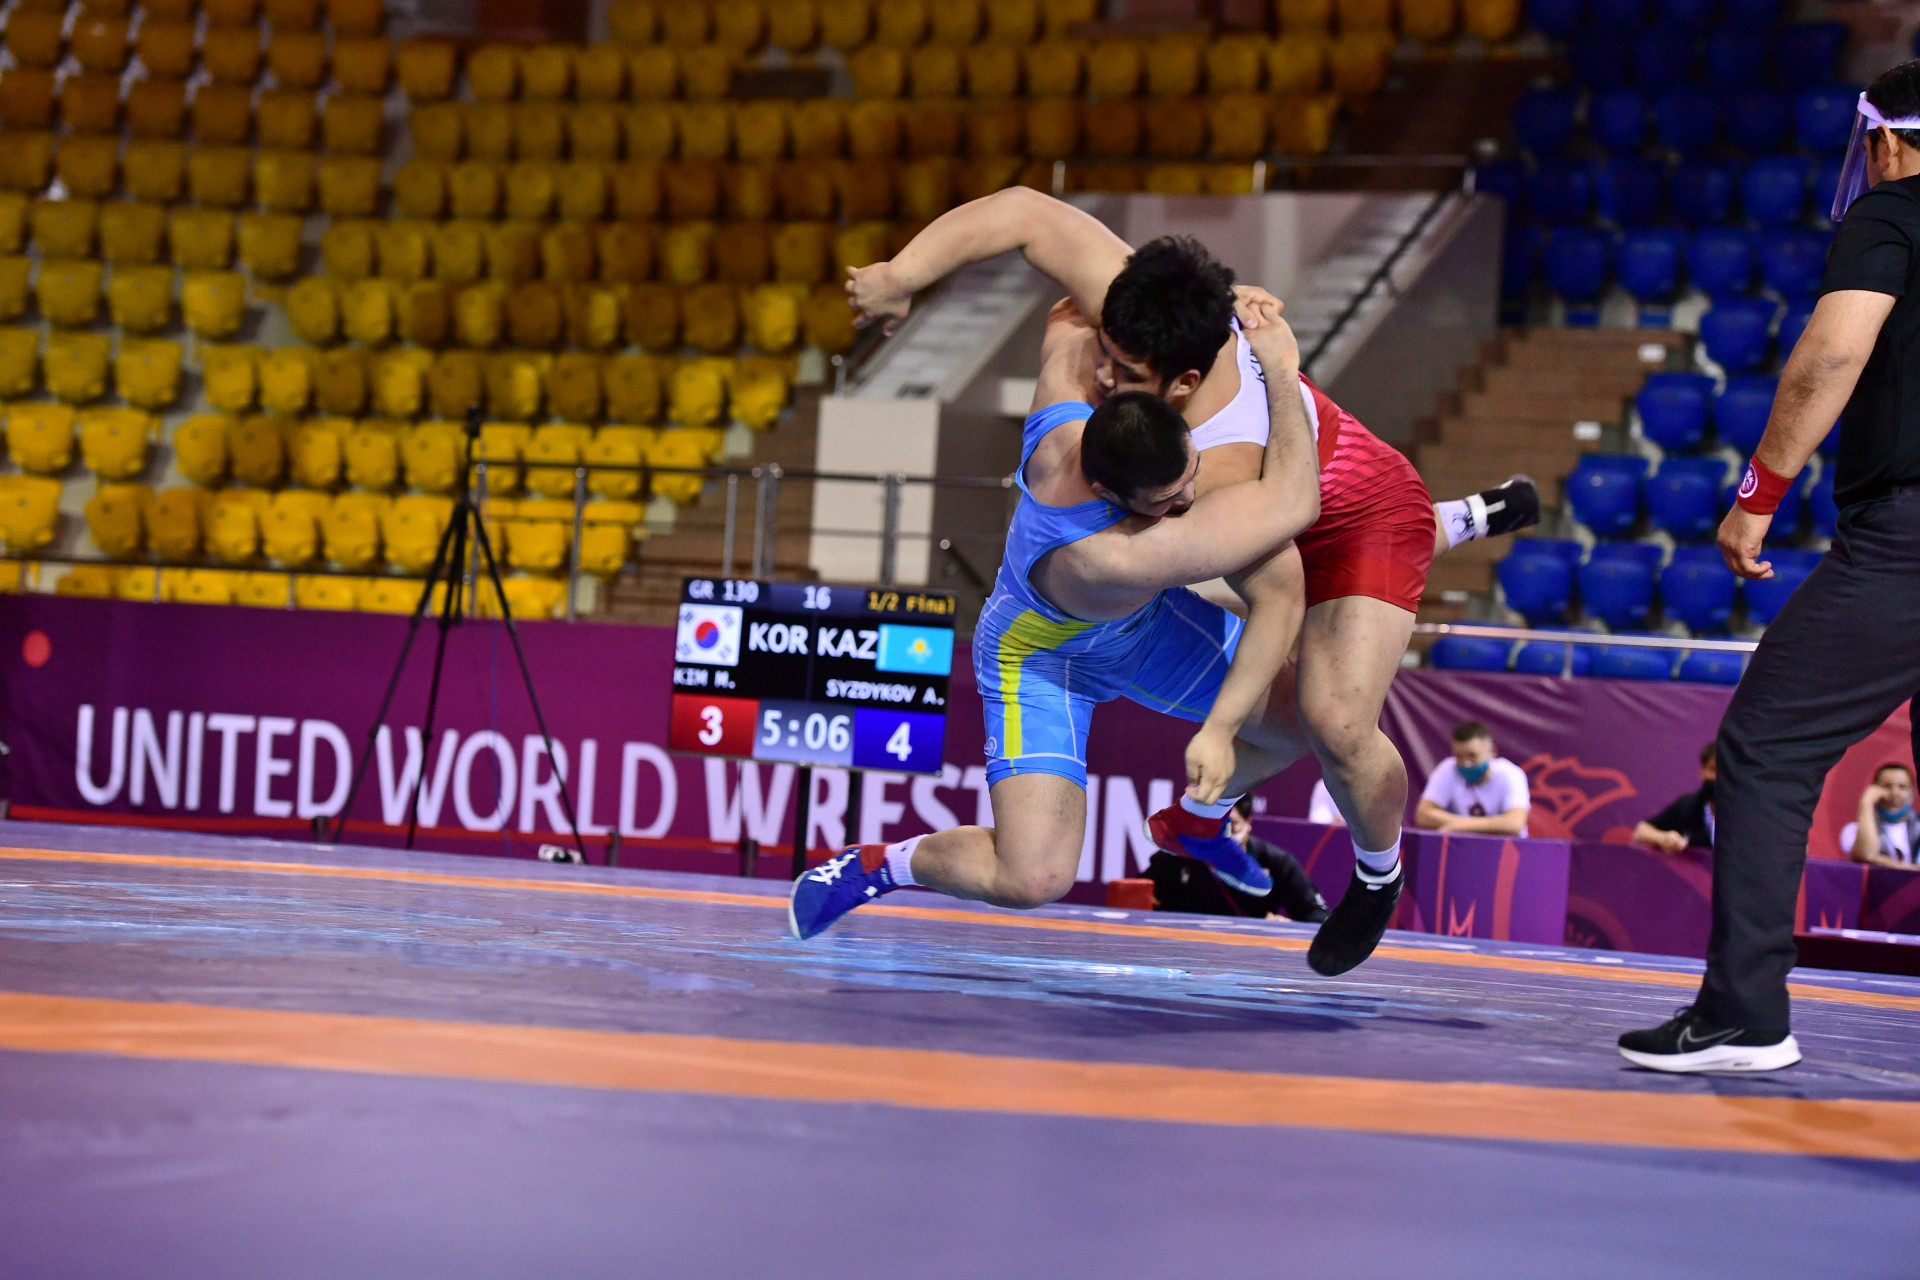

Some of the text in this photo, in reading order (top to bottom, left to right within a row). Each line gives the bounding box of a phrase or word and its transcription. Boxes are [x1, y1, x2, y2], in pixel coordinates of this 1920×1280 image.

[688, 579, 759, 603] GR 130
[803, 585, 831, 610] 16
[868, 591, 955, 614] 1/2 Final
[748, 622, 808, 655] KOR
[817, 627, 878, 660] KAZ
[826, 678, 945, 705] SYZDYKOV A.
[698, 705, 723, 746] 3
[761, 709, 850, 752] 5:06
[885, 721, 912, 762] 4
[76, 704, 352, 819] UNITED
[376, 725, 678, 839] WORLD
